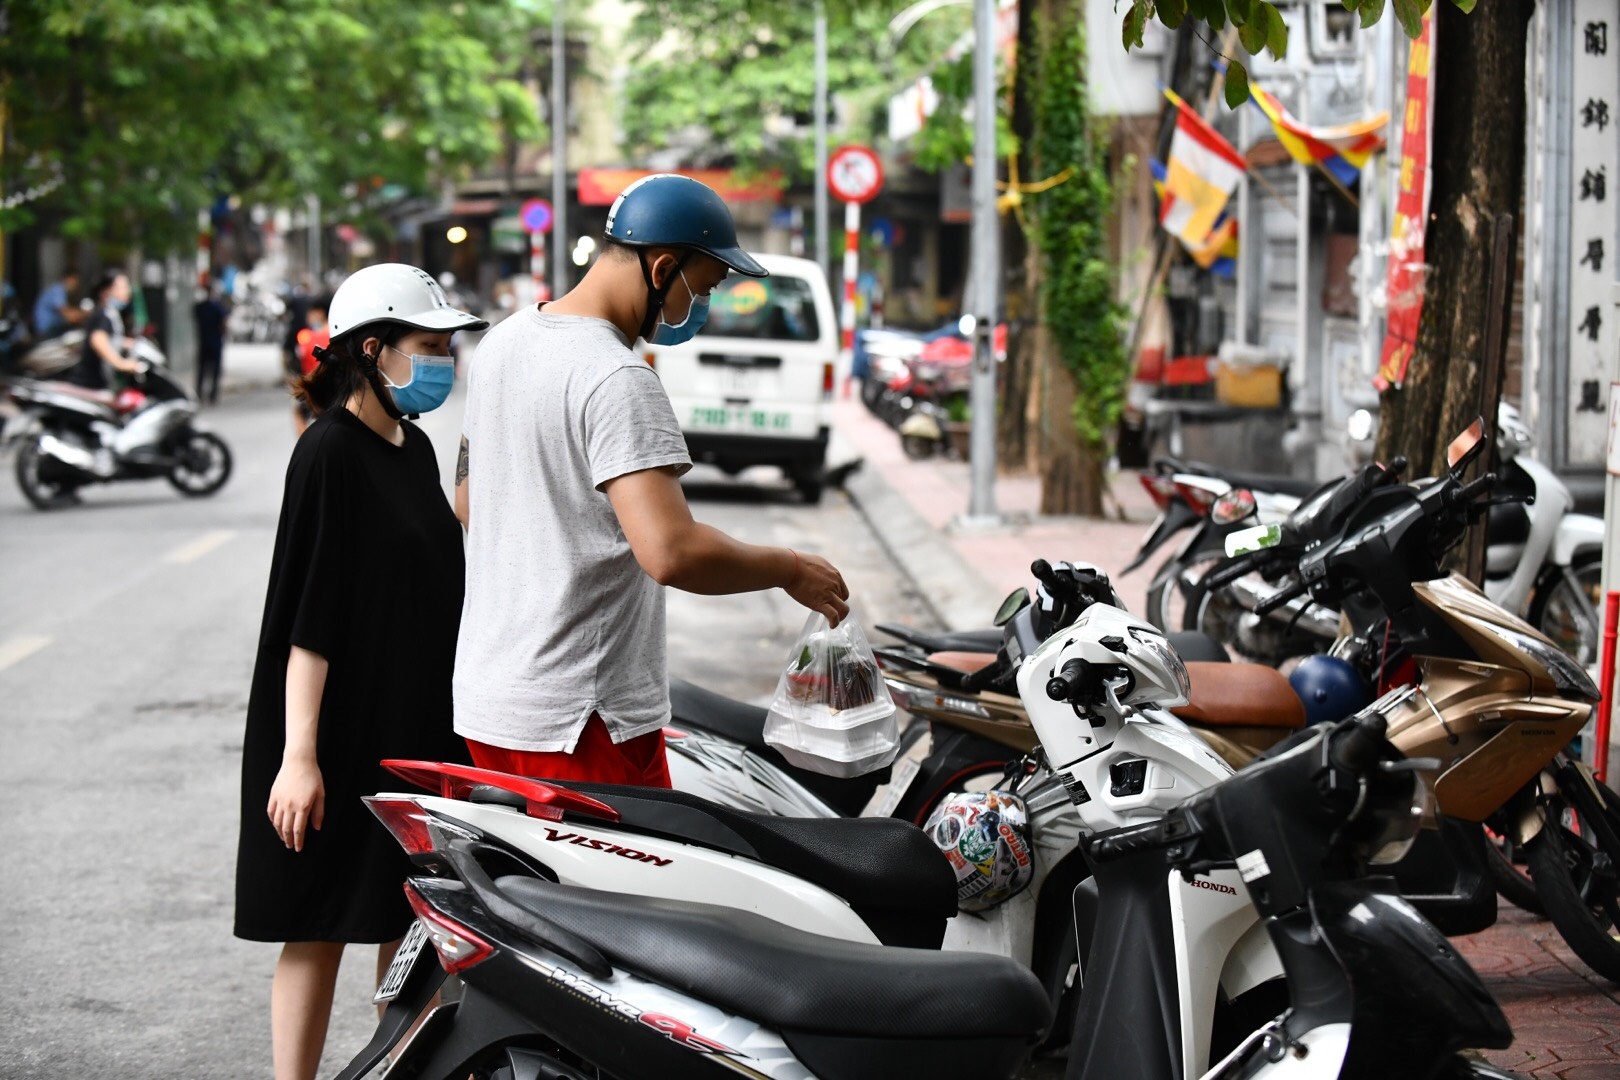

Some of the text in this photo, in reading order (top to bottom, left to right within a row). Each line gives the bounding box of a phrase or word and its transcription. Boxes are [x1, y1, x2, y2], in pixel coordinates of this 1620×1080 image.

[544, 827, 673, 866] VISION
[999, 825, 1030, 867] RETRO
[1190, 880, 1237, 895] HONDA
